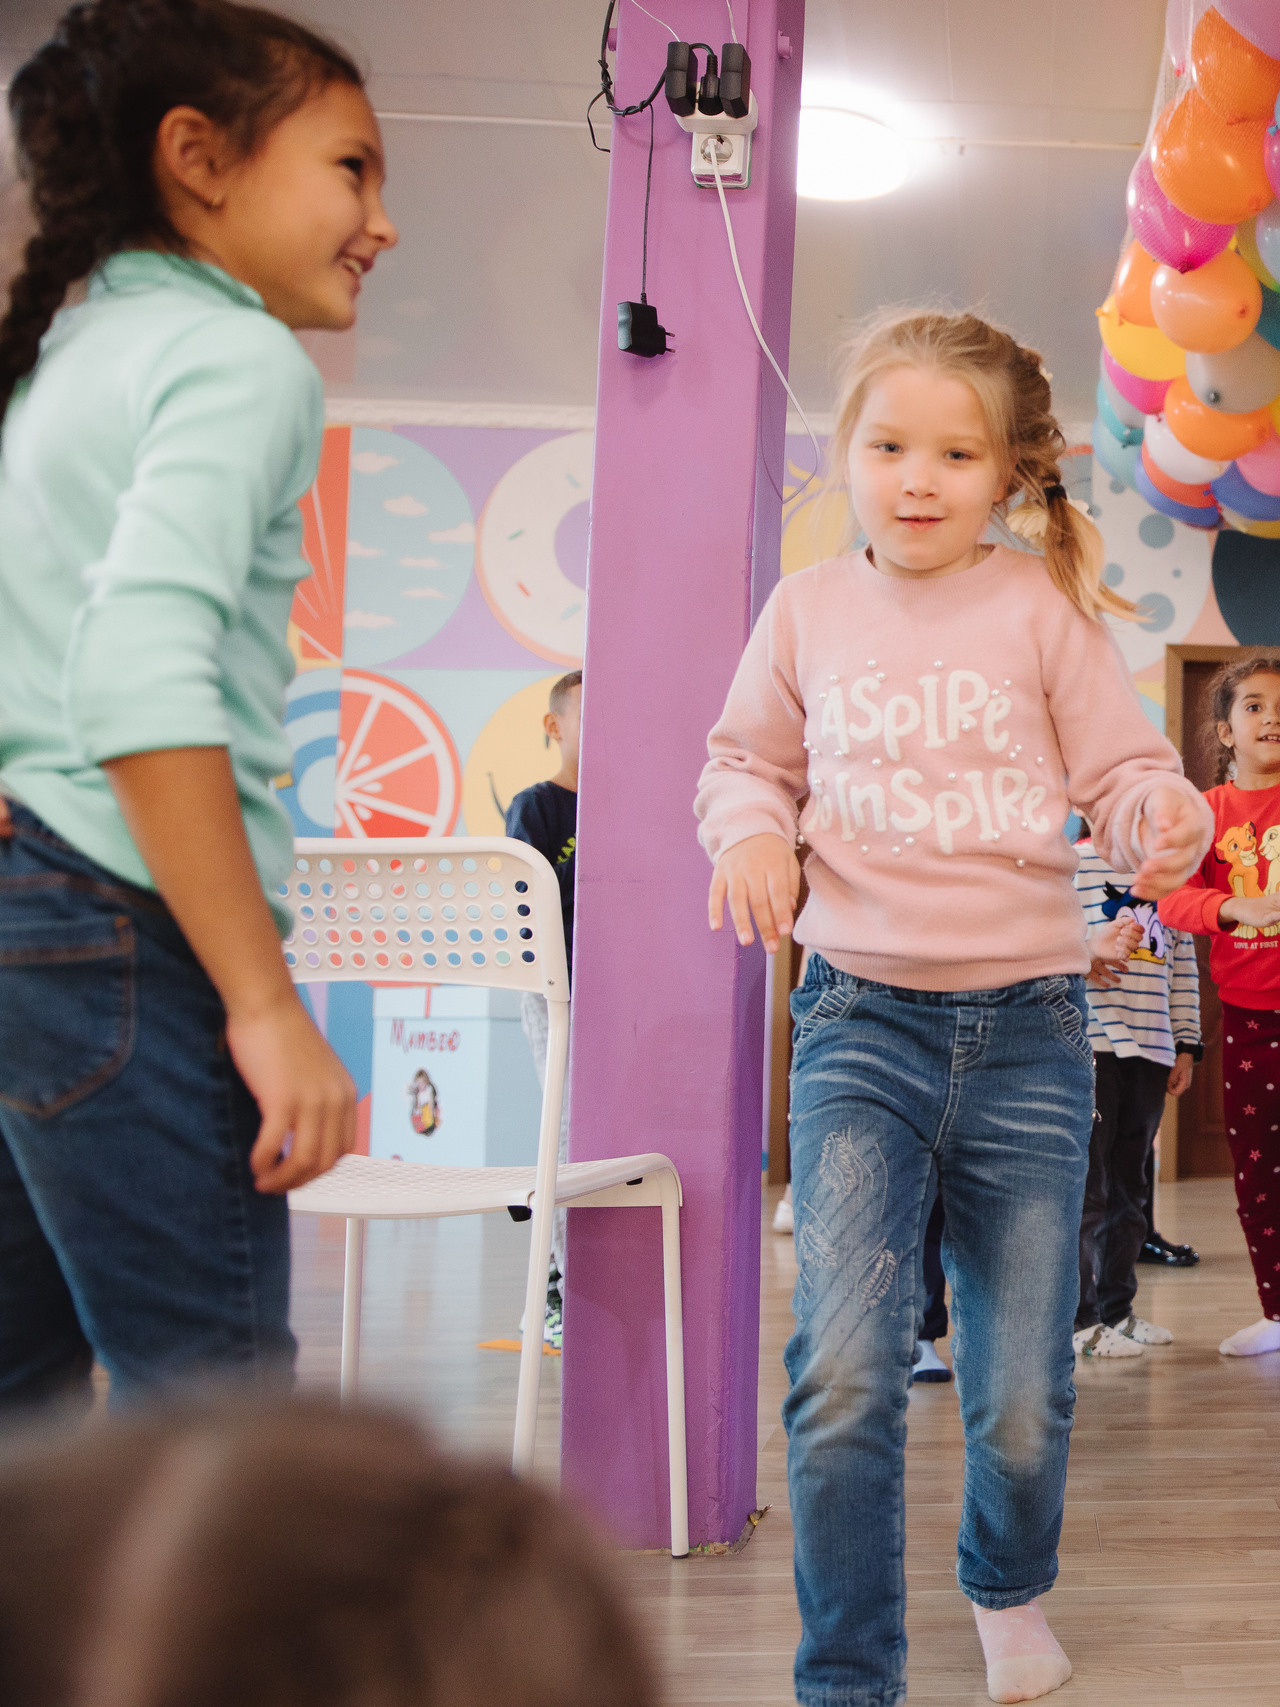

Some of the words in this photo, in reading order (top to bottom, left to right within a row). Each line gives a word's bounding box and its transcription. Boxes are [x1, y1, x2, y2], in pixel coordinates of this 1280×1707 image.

[1234, 941, 1249, 949] LOVE
[1250, 941, 1258, 949] AT
[1260, 940, 1278, 948] FIRST
